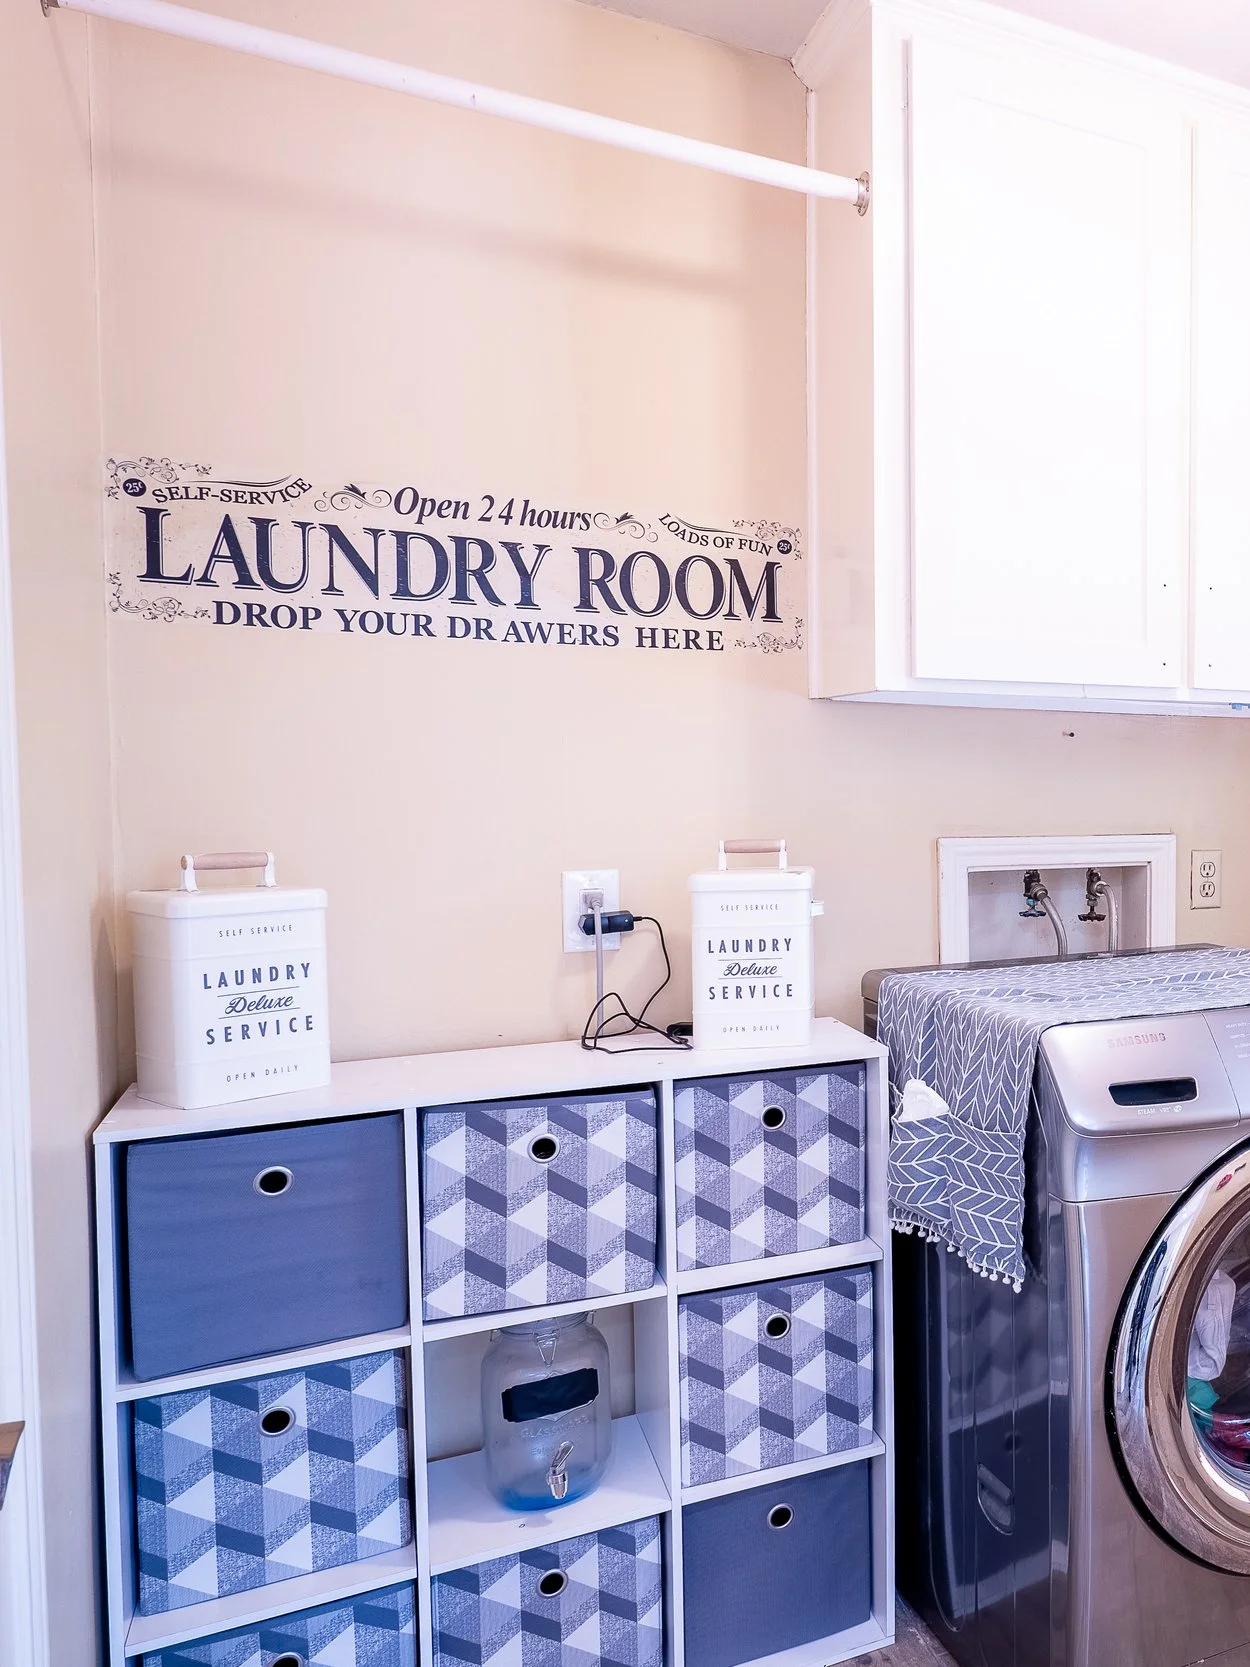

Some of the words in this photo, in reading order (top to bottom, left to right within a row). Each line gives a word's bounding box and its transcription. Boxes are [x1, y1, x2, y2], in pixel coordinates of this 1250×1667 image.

[151, 477, 312, 505] SELF-SERVICE
[393, 486, 471, 524] Open
[477, 494, 513, 526] 24
[520, 499, 592, 532] hours
[658, 512, 709, 547] LOADS
[712, 535, 735, 550] OF
[738, 539, 773, 557] FUN
[136, 505, 553, 611] LAUNDRY
[572, 546, 784, 624] ROOM
[212, 600, 322, 631] DROP
[333, 608, 437, 638] YOUR
[446, 615, 620, 648] DRAWERS
[635, 626, 725, 652] HERE
[745, 903, 779, 911] SERVICE
[219, 928, 243, 938] SELF
[250, 924, 293, 935] SERVICE
[708, 937, 792, 954] LAUNDRY
[203, 962, 311, 990] LAUNDRY
[723, 962, 778, 977] Deluxe
[708, 983, 793, 1000] SERVICE
[224, 994, 294, 1016] Deluxe
[206, 1014, 314, 1046] SERVICE
[752, 1024, 780, 1032] DAILY
[1107, 1032, 1166, 1049] SAMSUNG
[226, 1071, 256, 1083] OPEN
[265, 1064, 299, 1077] DAILY
